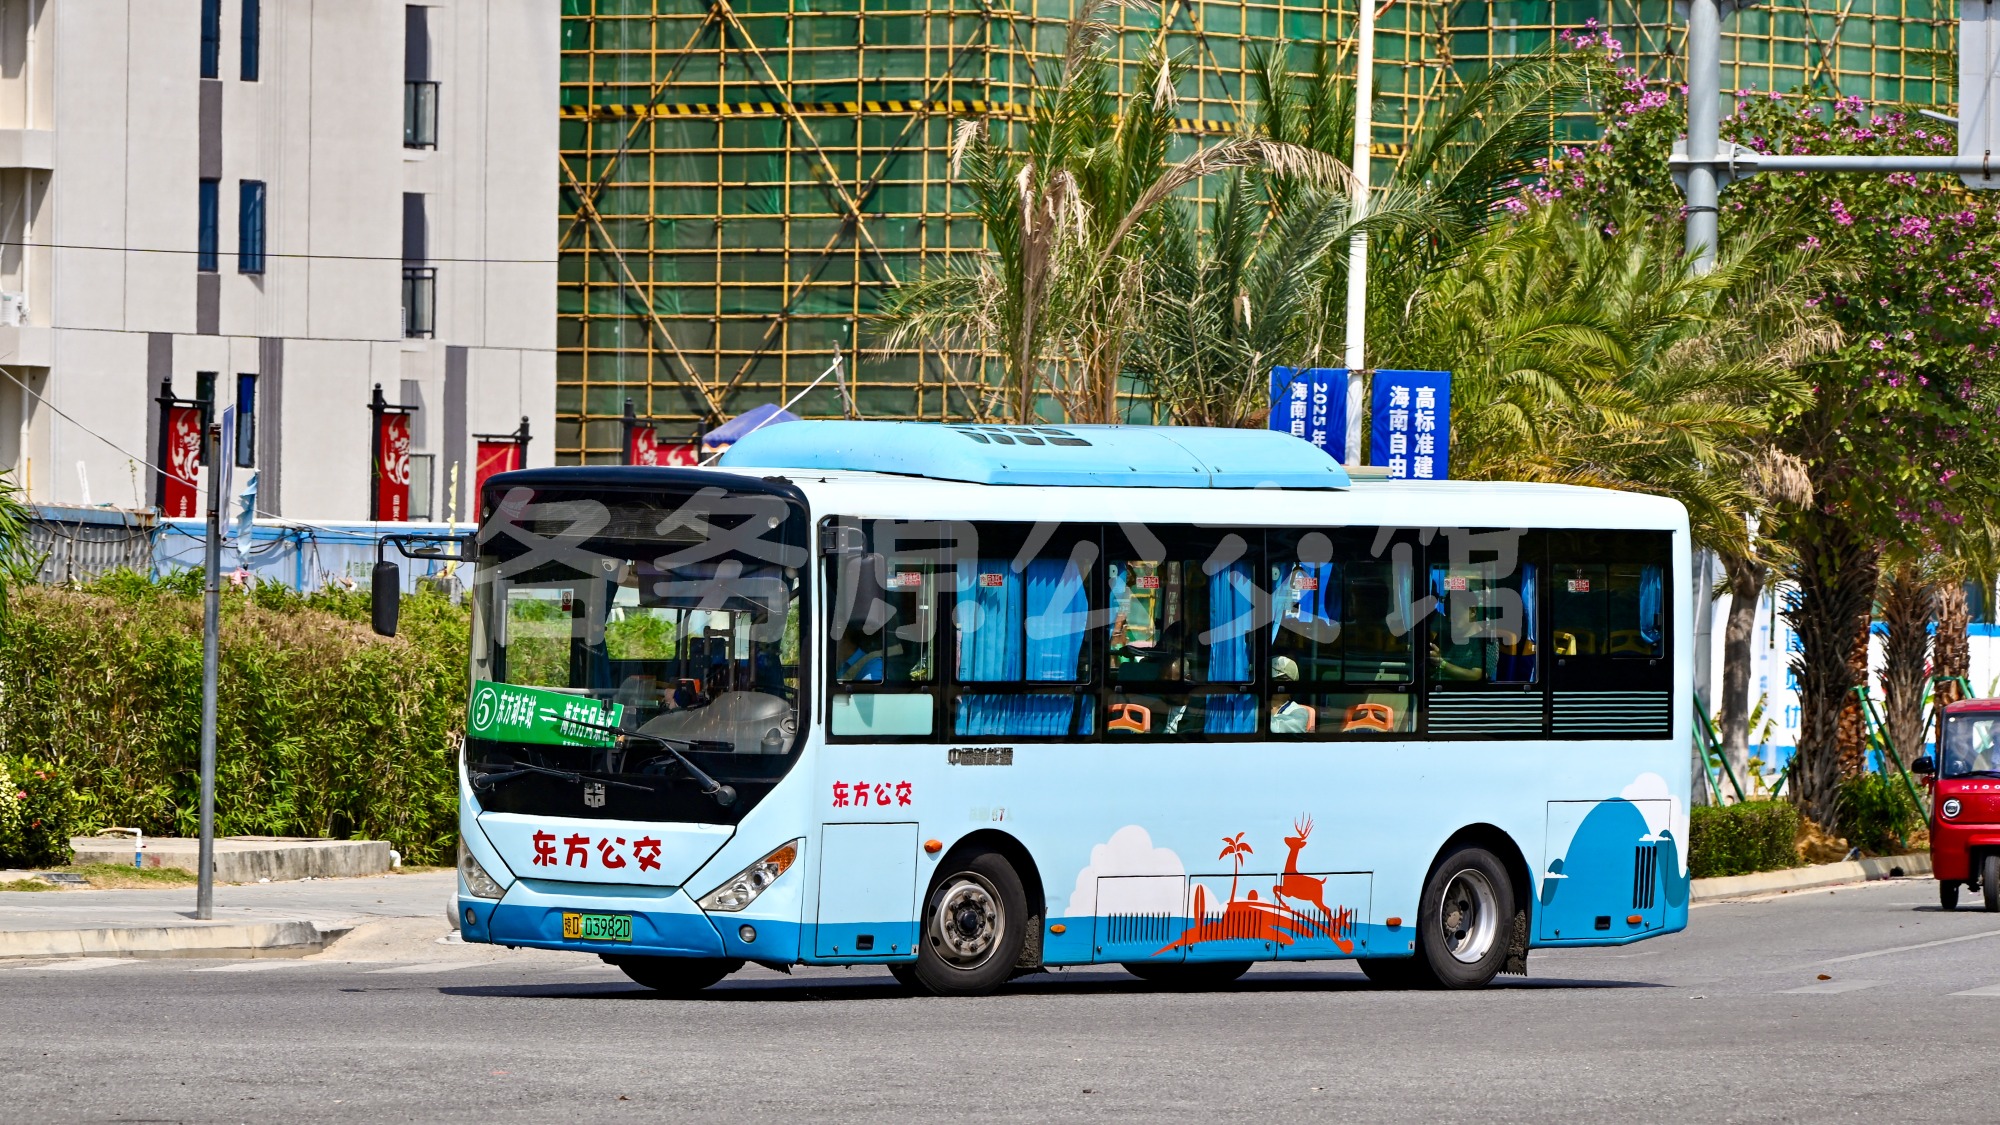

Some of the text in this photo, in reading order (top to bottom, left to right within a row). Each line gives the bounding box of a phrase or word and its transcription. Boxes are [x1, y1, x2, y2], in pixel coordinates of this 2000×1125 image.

[1413, 386, 1436, 478] 高标准建
[496, 689, 537, 729] 东方动车站
[832, 780, 913, 808] 东方公交
[532, 829, 663, 872] 东方公交
